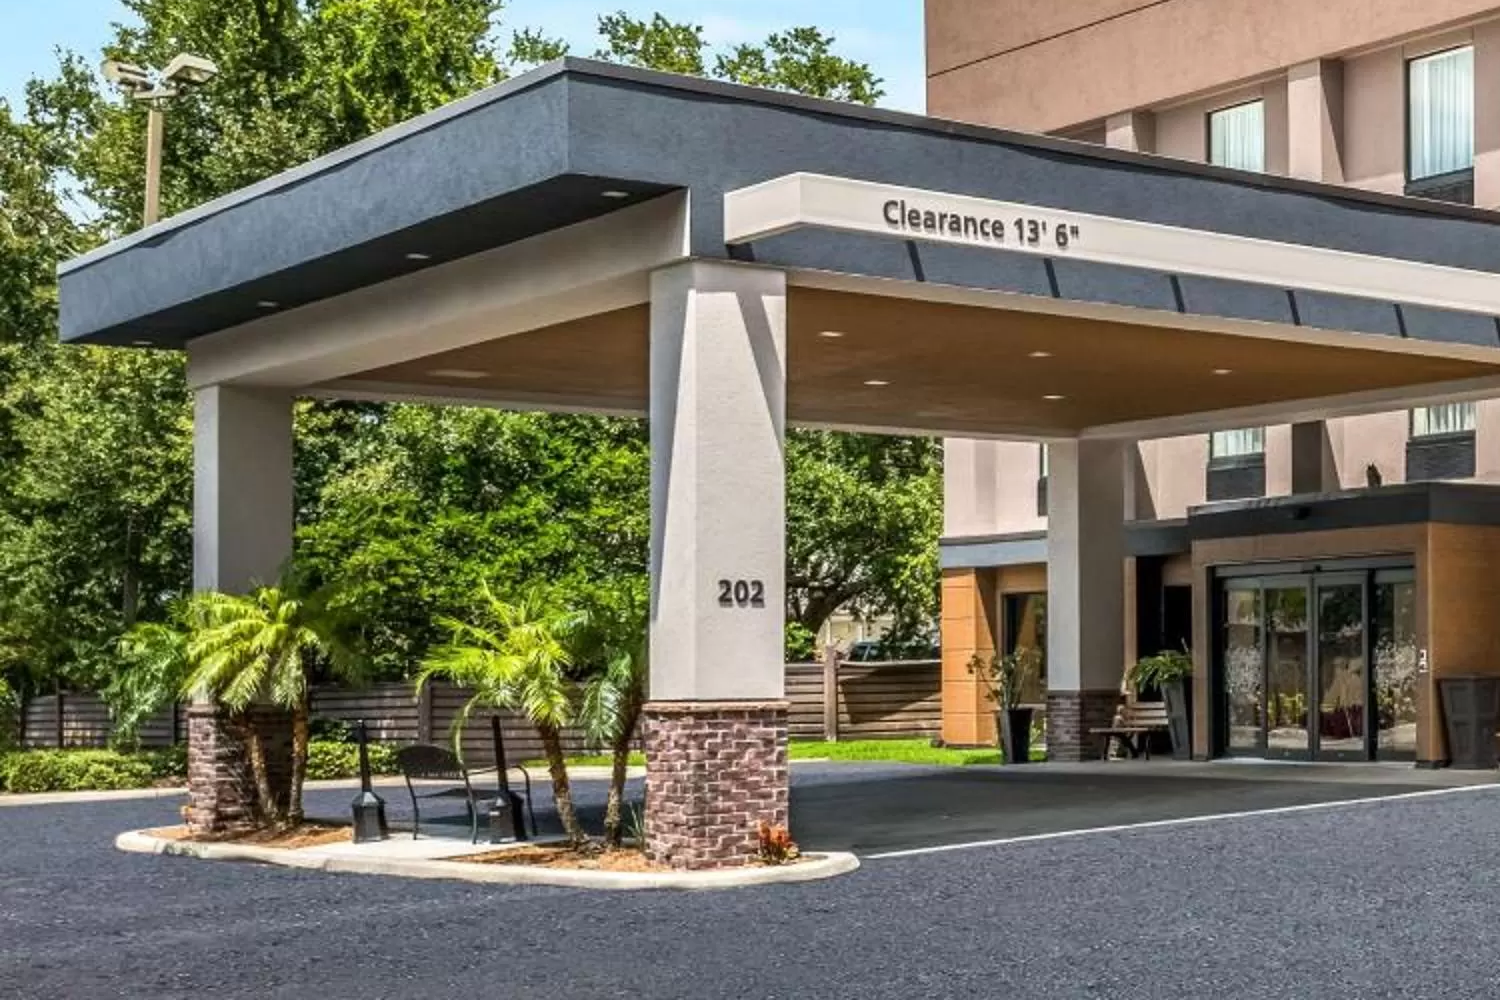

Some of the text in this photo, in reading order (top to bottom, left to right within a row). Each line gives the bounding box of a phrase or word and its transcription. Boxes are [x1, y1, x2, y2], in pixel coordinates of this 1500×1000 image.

[883, 200, 1080, 249] Clearance 13' 6"
[717, 579, 766, 608] 202
